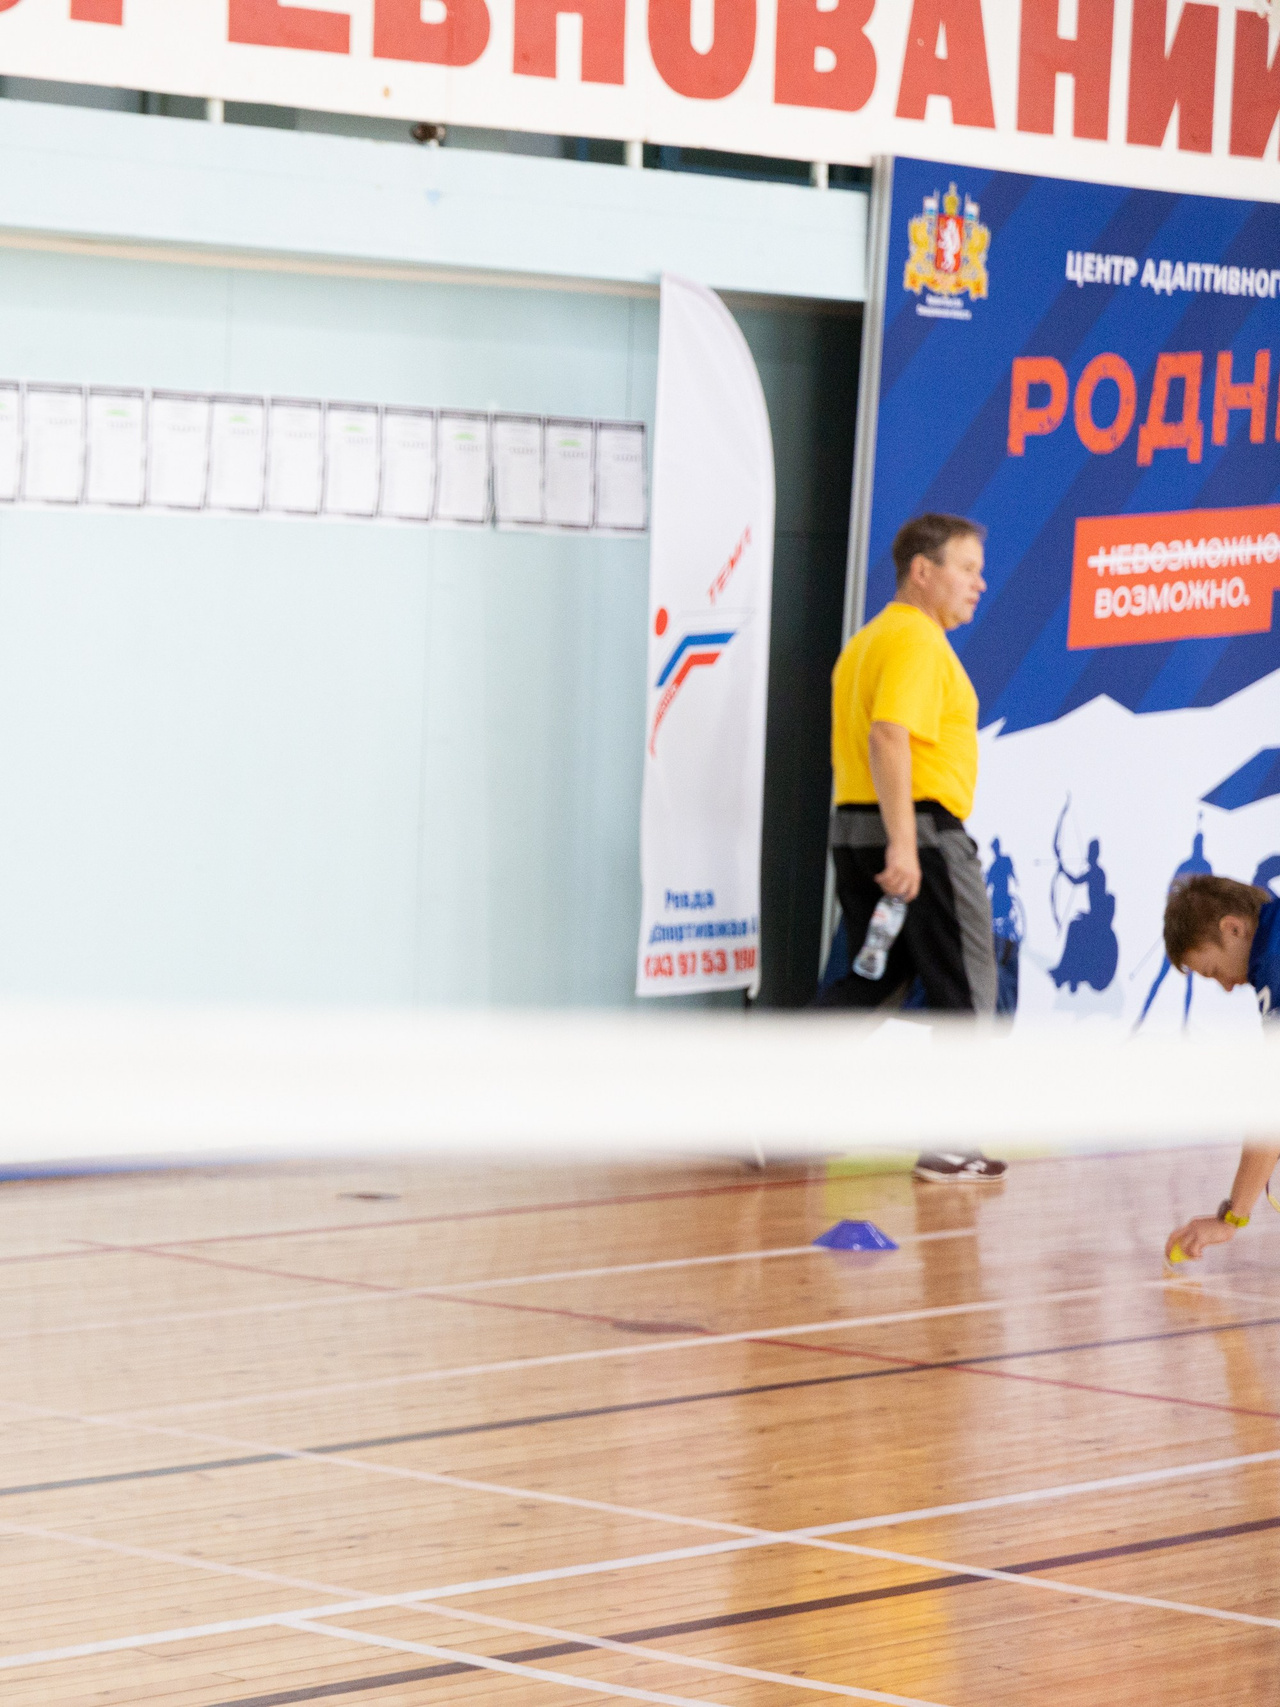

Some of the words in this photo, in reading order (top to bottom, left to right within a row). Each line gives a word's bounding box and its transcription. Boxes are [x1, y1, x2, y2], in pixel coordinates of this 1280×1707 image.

[1065, 250, 1139, 288] ЦЕНТР
[1007, 349, 1280, 467] РОДН
[1094, 576, 1251, 619] ВОЗМОЖНО.
